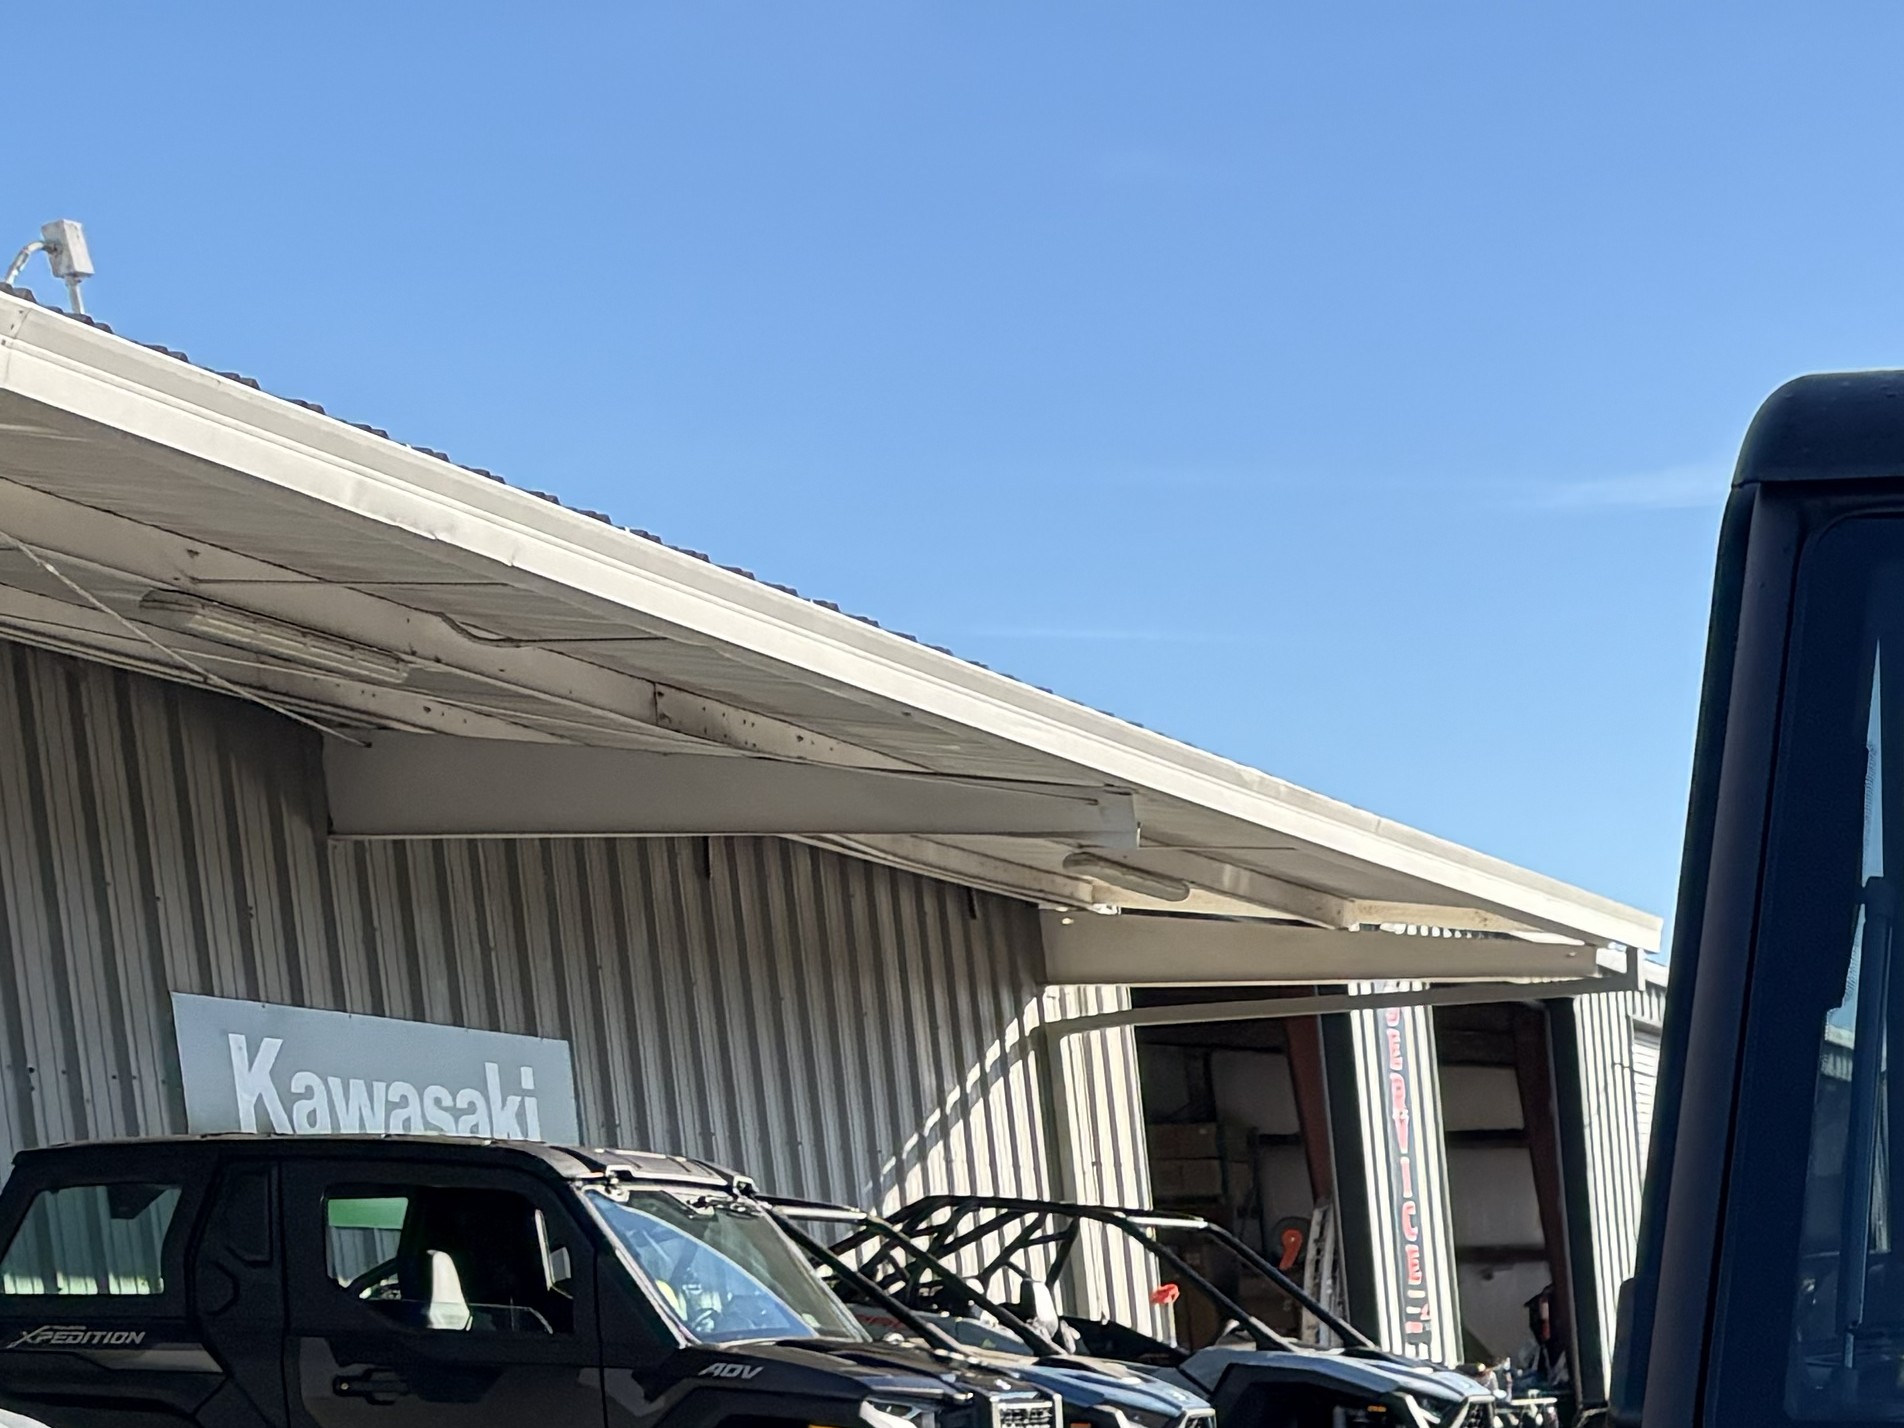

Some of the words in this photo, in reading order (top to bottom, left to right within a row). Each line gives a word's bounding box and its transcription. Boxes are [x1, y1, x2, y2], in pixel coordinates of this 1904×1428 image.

[227, 1032, 542, 1143] Kawasaki
[6, 1325, 146, 1350] XPEDITION
[697, 1362, 764, 1380] ADV
